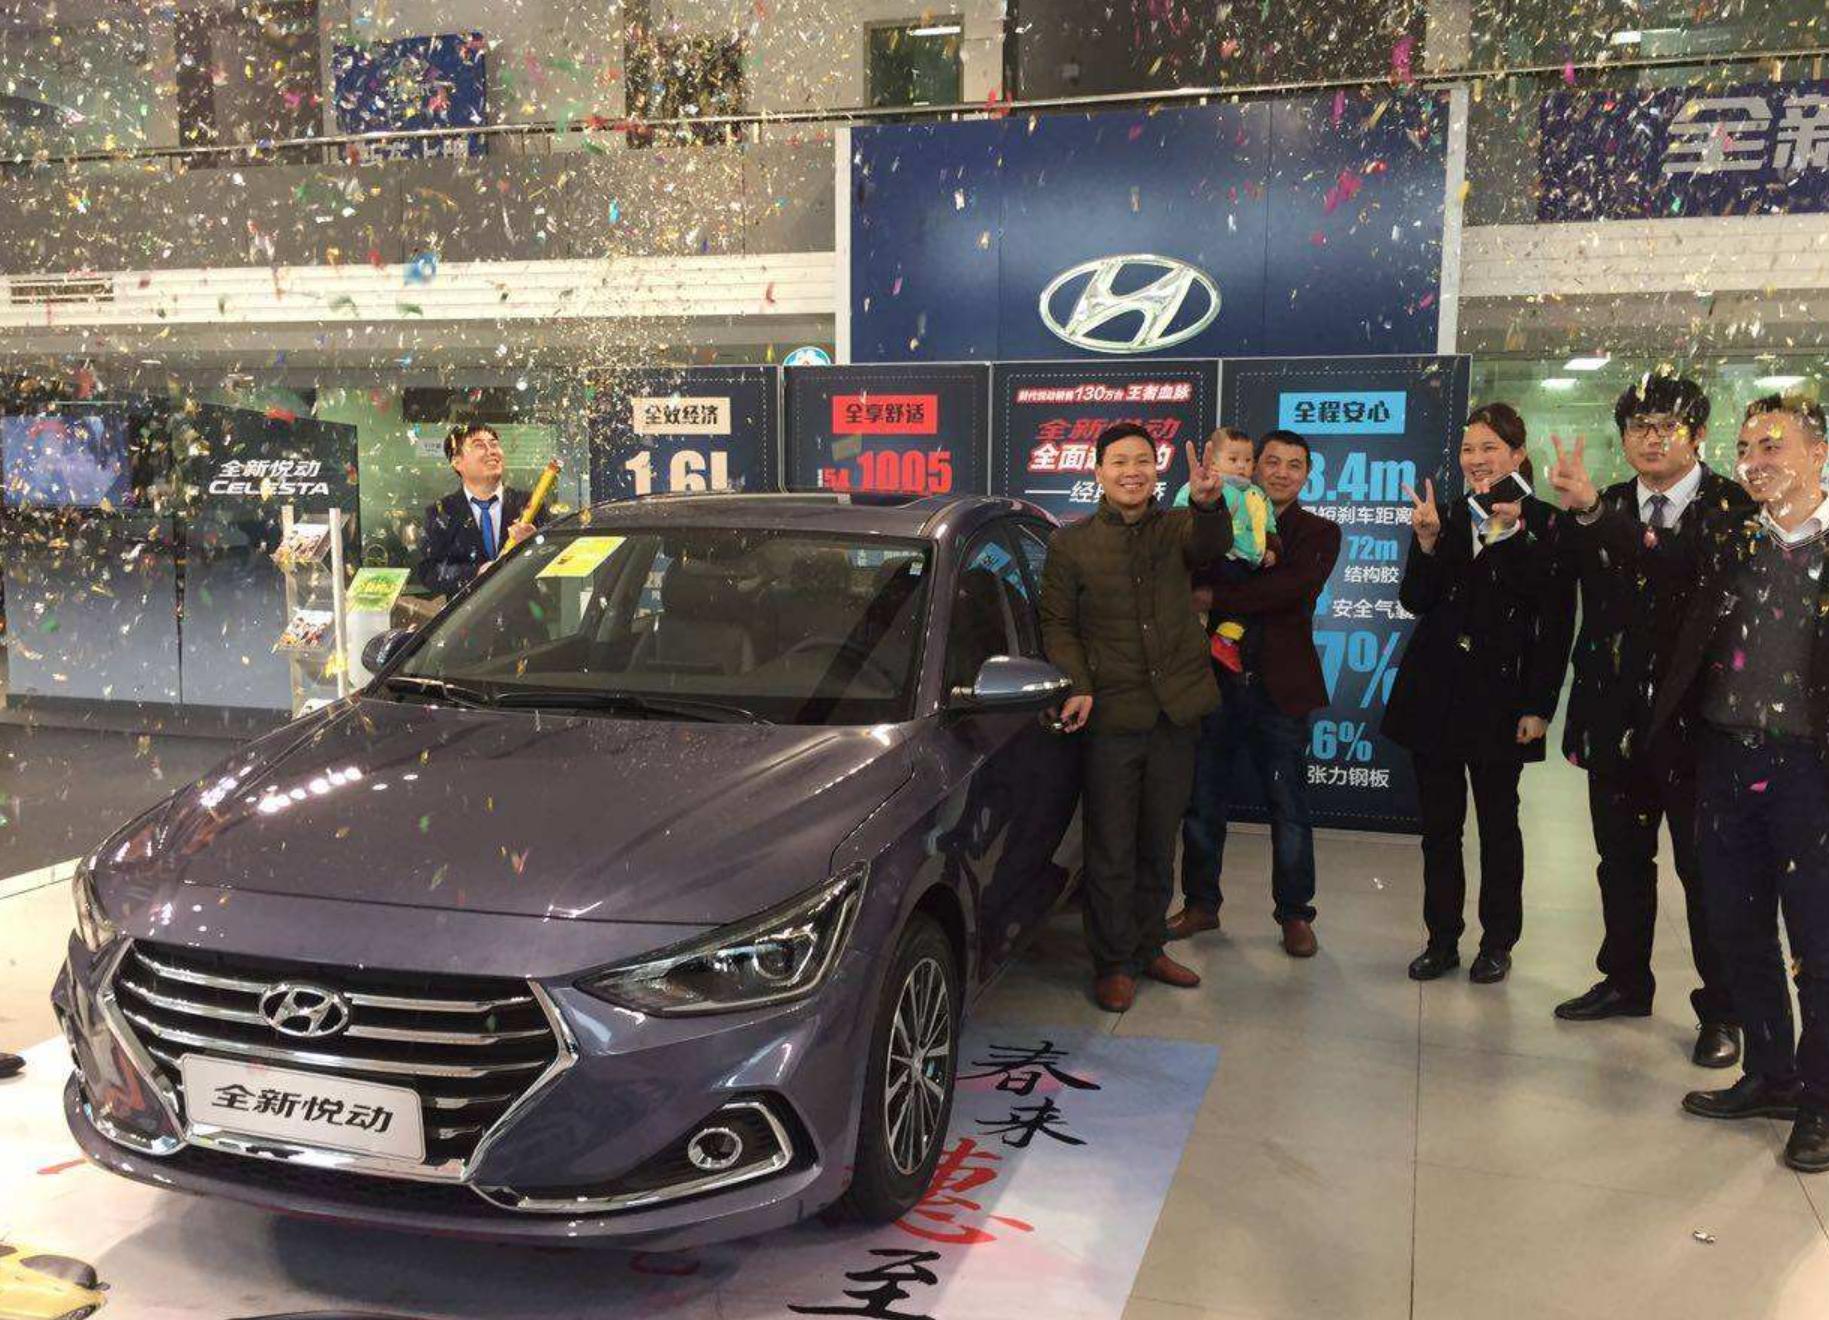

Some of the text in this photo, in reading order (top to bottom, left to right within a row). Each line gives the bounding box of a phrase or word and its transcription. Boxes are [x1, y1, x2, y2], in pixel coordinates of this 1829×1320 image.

[644, 404, 718, 425] 全效经济
[846, 403, 924, 424] 全享舒适
[1294, 400, 1390, 423] 全程安心
[1035, 418, 1182, 443] 全新动
[219, 459, 321, 477] 全新悦动
[857, 449, 953, 495] 1005
[1301, 505, 1412, 524] 短刹车距离
[1347, 535, 1398, 560] 72m
[1344, 565, 1399, 583] 结构胶
[1307, 765, 1390, 788] 张力钢板
[211, 1083, 394, 1133] 全新悦动
